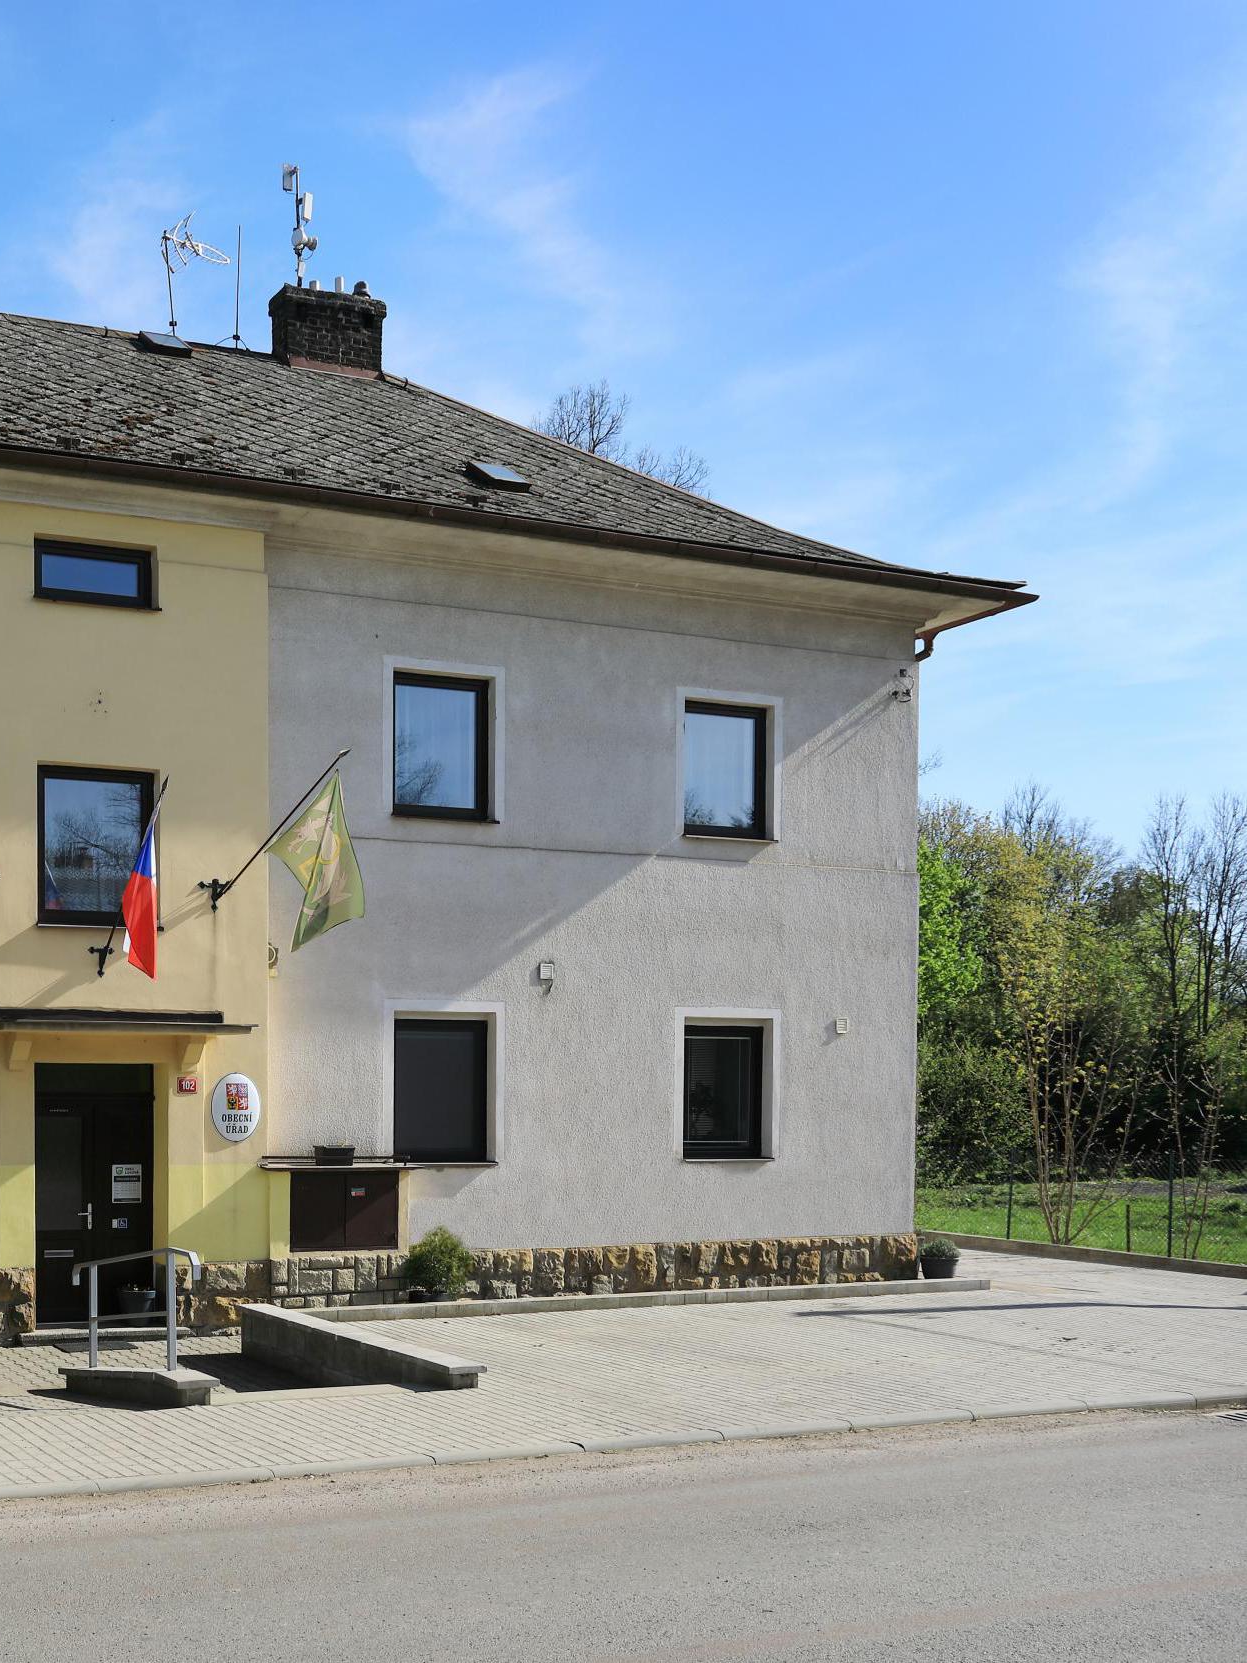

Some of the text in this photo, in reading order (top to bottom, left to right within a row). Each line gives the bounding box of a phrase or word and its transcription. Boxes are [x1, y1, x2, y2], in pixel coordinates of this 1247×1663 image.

[182, 1080, 195, 1090] 102
[221, 1112, 252, 1123] OBECNÍ
[226, 1123, 249, 1134] ÚŘAD
